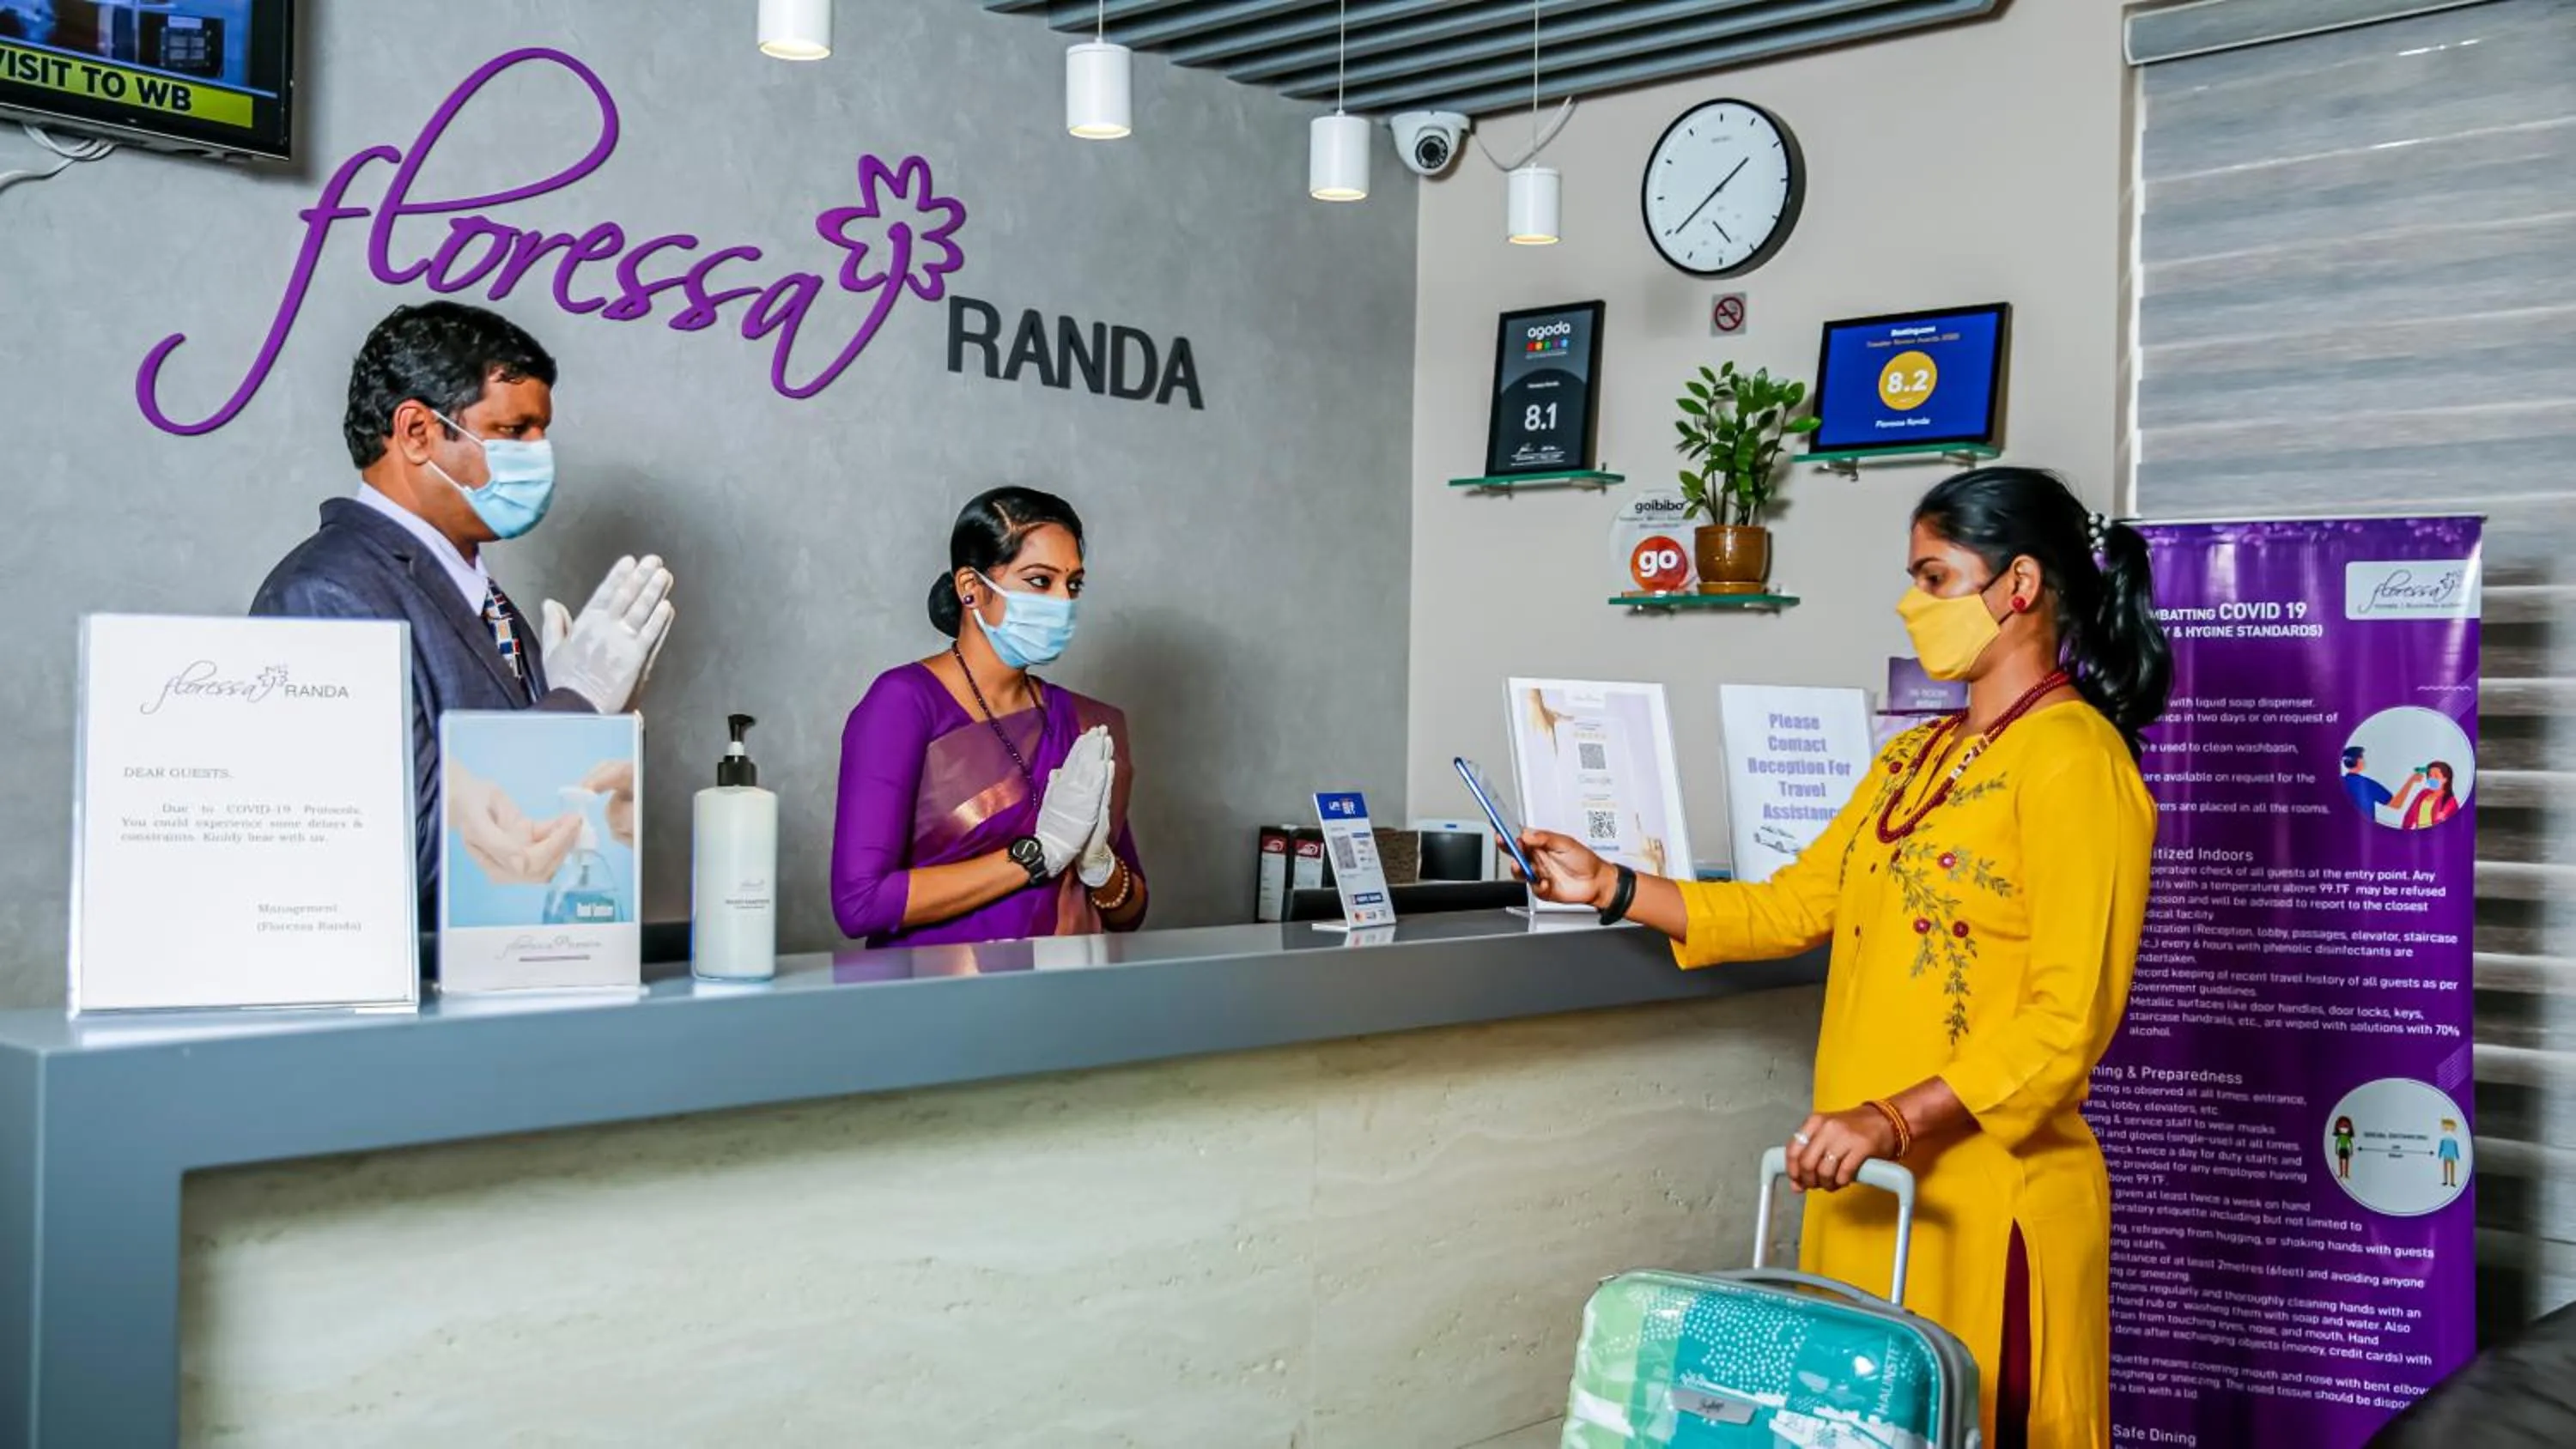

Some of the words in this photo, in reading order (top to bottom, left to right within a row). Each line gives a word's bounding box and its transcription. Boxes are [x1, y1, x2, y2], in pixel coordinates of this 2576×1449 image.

[81, 66, 126, 98] TO
[136, 76, 191, 112] WB
[136, 47, 912, 435] floressa
[1527, 321, 1571, 340] agoda
[947, 294, 1204, 409] RANDA
[1886, 370, 1929, 394] 8.2
[1524, 402, 1558, 430] 8.1
[1635, 499, 1685, 514] goibibo
[1638, 549, 1678, 578] go
[2149, 609, 2216, 621] MBATTING
[2219, 603, 2281, 620] COVID
[2286, 603, 2307, 619] 19
[2173, 626, 2182, 638] &
[2185, 626, 2233, 638] HYGINE
[2236, 625, 2323, 638] STANDARDS)
[284, 684, 349, 699] RANDA
[1768, 714, 1820, 730] Please
[2325, 712, 2338, 723] of
[1767, 737, 1827, 753] Contact
[123, 767, 165, 778] DEAR
[1747, 758, 1826, 775] Reception
[1828, 760, 1851, 777] For
[2296, 773, 2316, 784] the
[1779, 781, 1826, 797] Travel
[162, 803, 188, 814] Due
[226, 803, 292, 815] COVID-19
[1762, 803, 1840, 821] Assistanc
[121, 817, 147, 828] You
[2198, 847, 2255, 862] Indoors
[2267, 868, 2305, 879] guests
[2322, 869, 2342, 879] the
[2344, 870, 2374, 882] entry
[2378, 870, 2409, 882] point.
[2412, 870, 2436, 882] Any
[2355, 886, 2381, 896] may
[2383, 885, 2399, 895] be
[2400, 885, 2446, 897] refused
[258, 903, 338, 916] Management
[2348, 900, 2360, 910] to
[2363, 900, 2382, 911] the
[2385, 900, 2429, 912] closest
[2351, 931, 2402, 942] elevator,
[2403, 931, 2458, 943] staircase
[2314, 944, 2391, 956] disinfectants
[2394, 949, 2414, 957] are
[2362, 977, 2378, 986] all
[2379, 978, 2421, 989] guests
[2422, 979, 2437, 989] as
[2439, 980, 2458, 991] per
[2357, 1006, 2391, 1018] locks,
[2394, 1007, 2424, 1020] keys,
[2349, 1022, 2403, 1034] solutions
[2406, 1023, 2432, 1034] with
[2435, 1024, 2460, 1037] 70%
[2127, 1066, 2136, 1079] &
[2142, 1066, 2244, 1085] Preparedness
[2366, 1243, 2391, 1255] with
[2394, 1246, 2434, 1258] guests
[2306, 1269, 2329, 1280] and
[2330, 1270, 2379, 1287] avoiding
[2382, 1276, 2425, 1288] anyone
[2340, 1301, 2375, 1315] hands
[2378, 1305, 2403, 1318] with
[2406, 1308, 2422, 1319] an
[2292, 1313, 2319, 1325] soap
[2321, 1315, 2343, 1326] and
[2385, 1320, 2410, 1333] Also
[2348, 1332, 2379, 1345] Hand
[2329, 1346, 2363, 1360] credit
[2366, 1350, 2403, 1364] cards)
[2405, 1353, 2433, 1366] with
[2281, 1372, 2302, 1383] and
[2305, 1375, 2333, 1385] nose
[2335, 1377, 2360, 1389] with
[2363, 1379, 2391, 1392] bent
[2314, 1390, 2354, 1404] should
[2355, 1394, 2371, 1405] be
[2112, 1423, 2146, 1440] Safe
[2149, 1428, 2196, 1446] Dining
